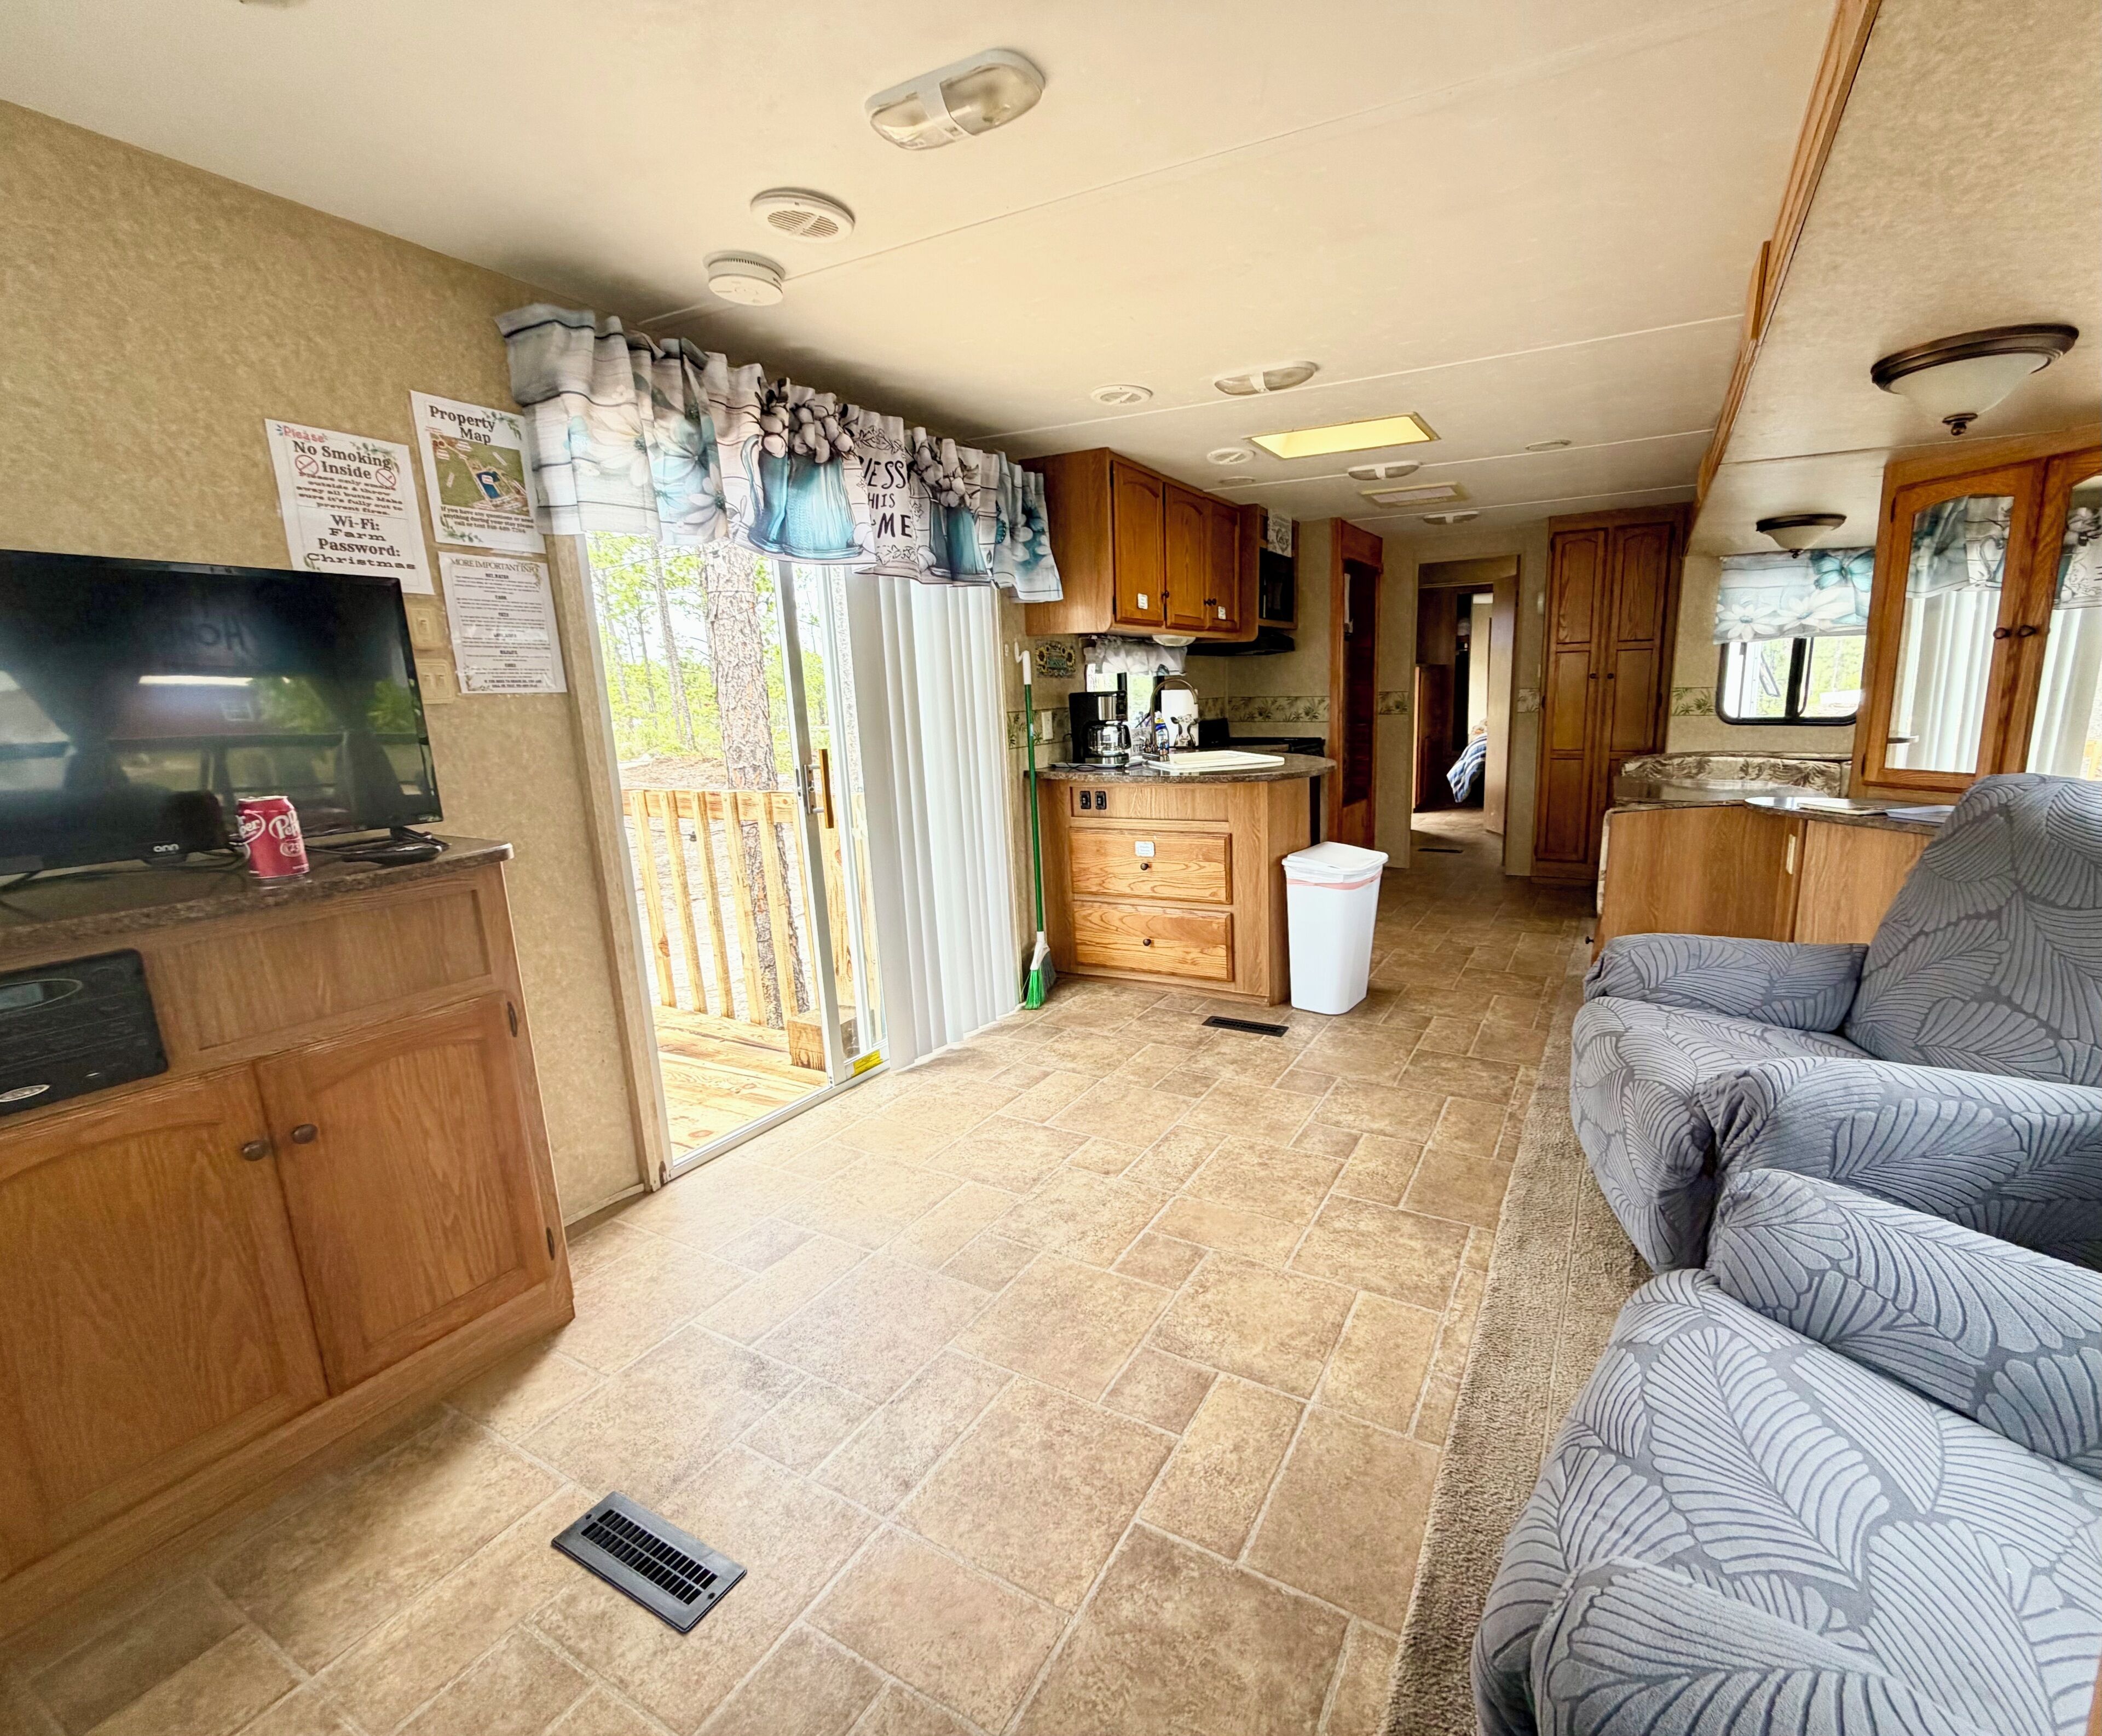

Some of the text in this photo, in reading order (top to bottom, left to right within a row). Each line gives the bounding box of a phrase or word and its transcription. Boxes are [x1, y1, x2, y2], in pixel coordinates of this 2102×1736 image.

[429, 405, 495, 432] Property
[283, 425, 325, 442] Please
[460, 427, 490, 445] Map
[292, 440, 391, 470] No Smoking
[321, 461, 371, 479] Inside
[858, 455, 906, 489] LESS
[308, 481, 349, 489] outside
[316, 502, 360, 511] prevent
[868, 492, 896, 509] HIS
[330, 514, 380, 530] Wi-Fi:
[328, 528, 386, 541] Farm
[317, 538, 401, 557] Password:
[307, 553, 416, 570] Christmas
[475, 561, 519, 571] IMPORTANT
[520, 564, 539, 573] INFO
